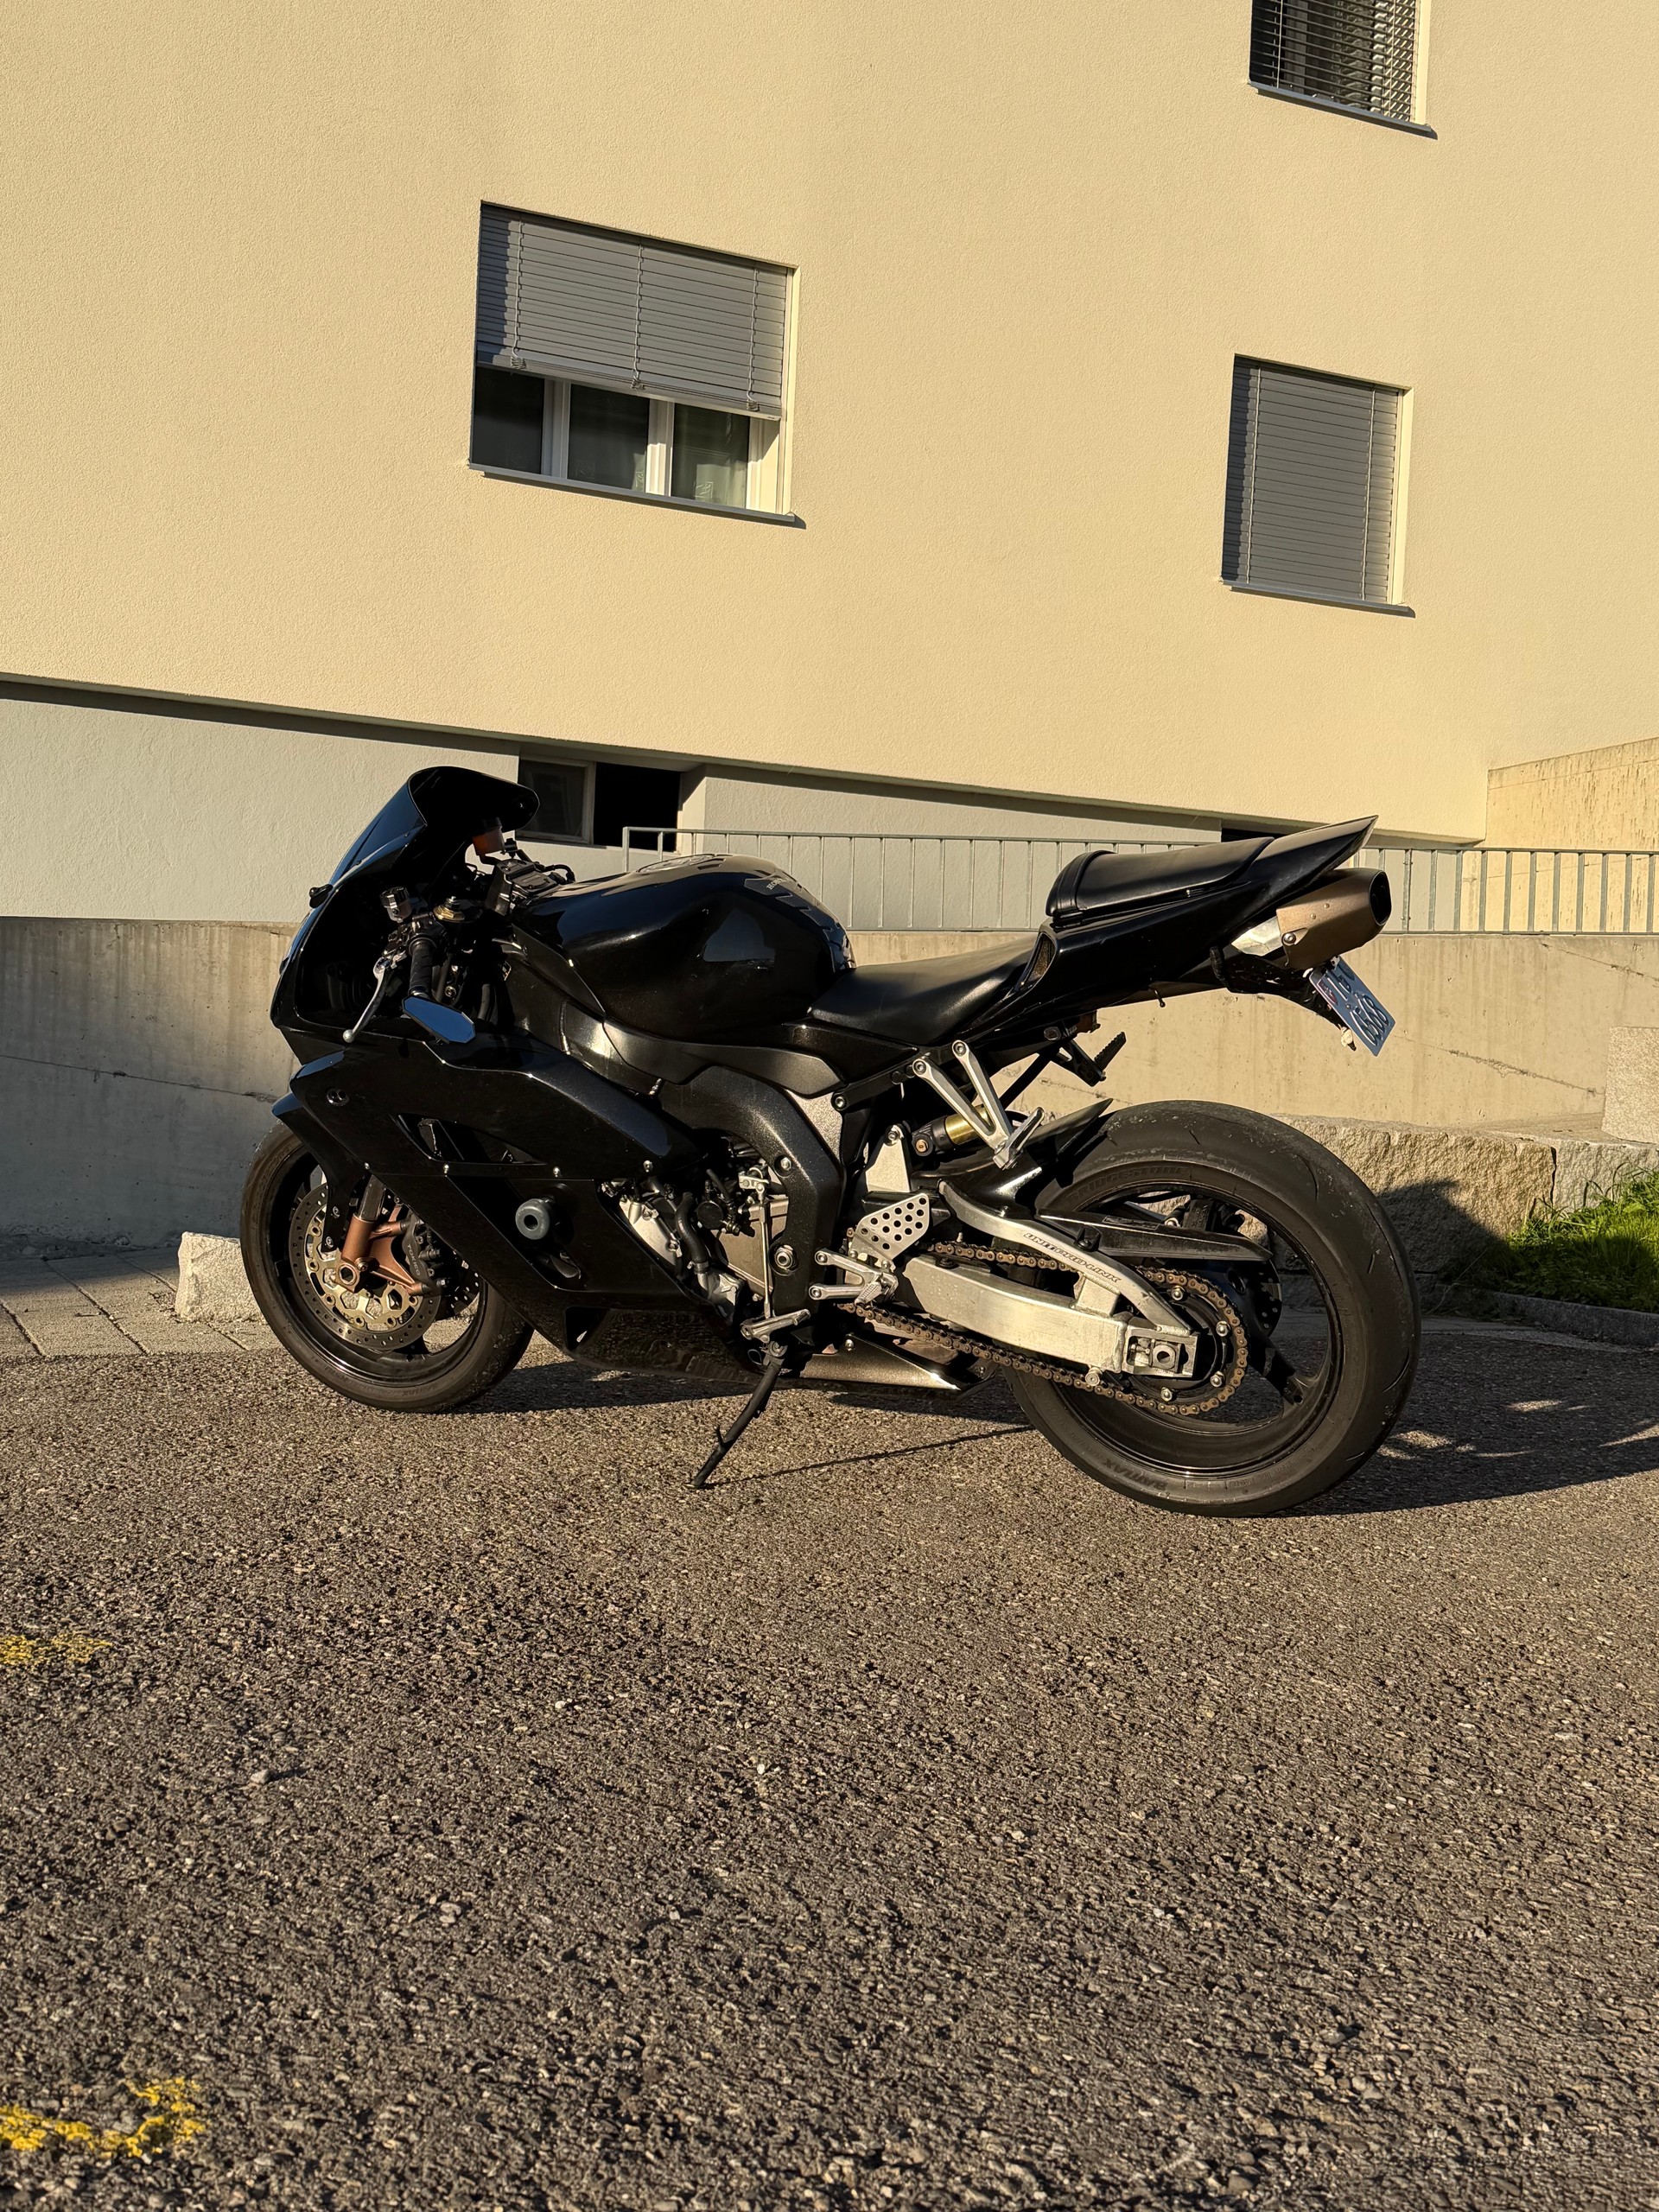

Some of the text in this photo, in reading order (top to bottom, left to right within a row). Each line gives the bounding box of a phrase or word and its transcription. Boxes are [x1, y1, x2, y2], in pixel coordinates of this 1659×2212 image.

[1350, 994, 1389, 1046] 6568
[1065, 1166, 1189, 1204] BRIDGESTONE
[407, 1243, 421, 1276] TOKICO
[1102, 1459, 1169, 1491] BATTLAX
